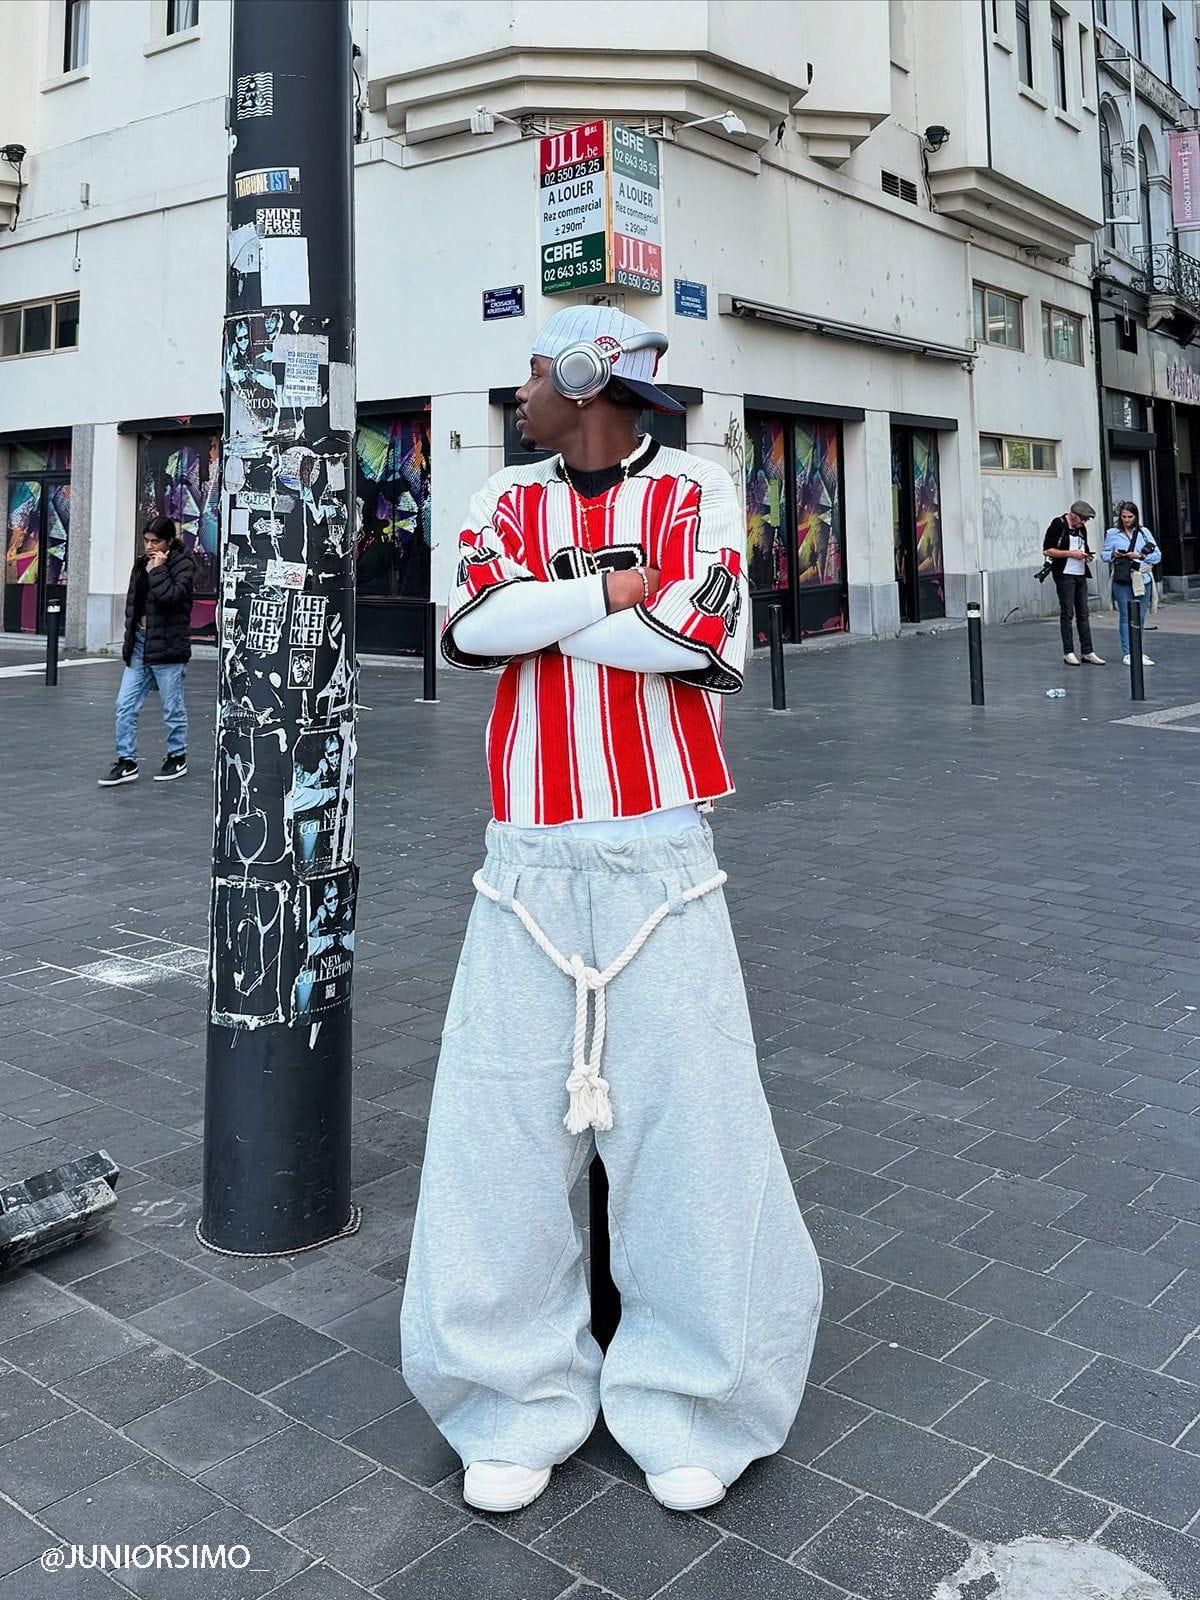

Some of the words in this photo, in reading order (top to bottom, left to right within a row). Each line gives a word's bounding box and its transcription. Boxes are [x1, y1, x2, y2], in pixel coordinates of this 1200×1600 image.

[614, 126, 644, 154] CBRE
[545, 172, 556, 185] 02
[557, 167, 573, 182] 550
[575, 163, 587, 177] 25
[588, 159, 600, 173] 25
[615, 149, 624, 163] 02
[625, 152, 638, 168] 643
[639, 159, 648, 172] 35
[648, 163, 657, 176] 35
[548, 191, 556, 206] A
[558, 180, 594, 202] LOUER
[619, 182, 625, 198] A
[627, 184, 654, 208] LOUER
[256, 208, 301, 220] SMINT
[543, 212, 557, 223] Rez
[558, 197, 602, 219] commercial
[615, 201, 626, 214] Rez
[627, 207, 659, 225] commercial
[544, 240, 583, 263] CBRE
[544, 269, 556, 281] 02
[557, 264, 574, 279] 643
[576, 261, 588, 275] 35
[590, 258, 602, 272] 35
[618, 271, 627, 285] 02
[628, 274, 641, 288] 550
[641, 277, 651, 291] 25
[651, 280, 660, 293] 25
[252, 601, 281, 618] KLET
[294, 596, 325, 612] KLET
[291, 629, 322, 644] KET
[319, 953, 342, 970] NEW
